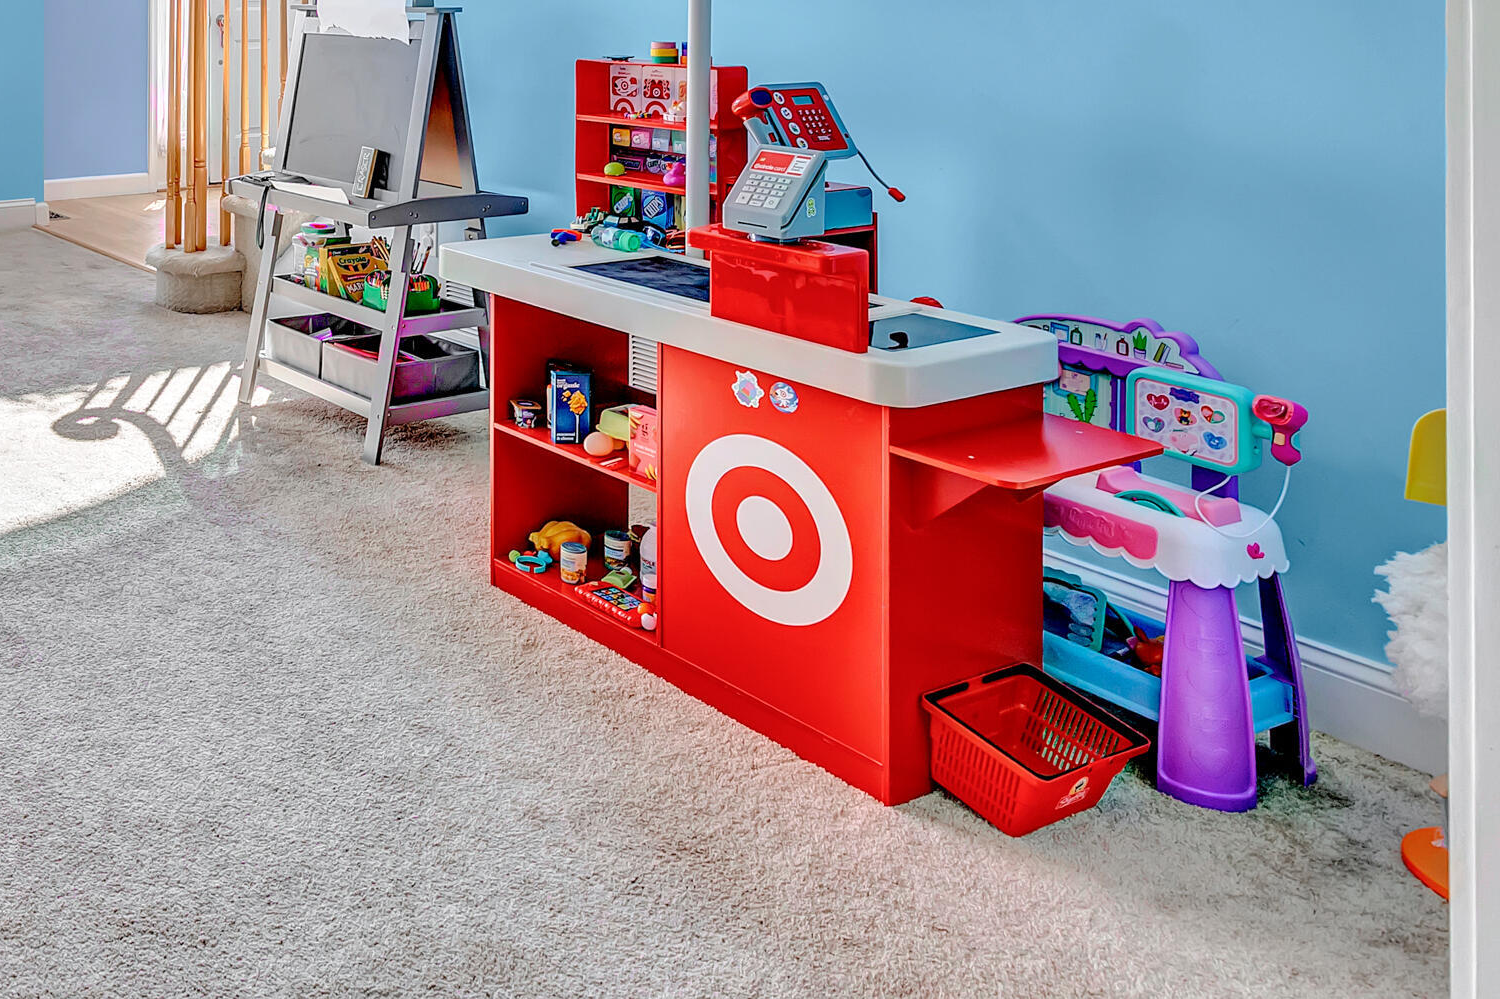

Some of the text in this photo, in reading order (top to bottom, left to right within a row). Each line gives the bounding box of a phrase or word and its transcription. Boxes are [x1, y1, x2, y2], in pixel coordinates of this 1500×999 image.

[643, 195, 665, 219] CHIPS
[338, 256, 368, 266] Crayola
[346, 282, 365, 294] MARK
